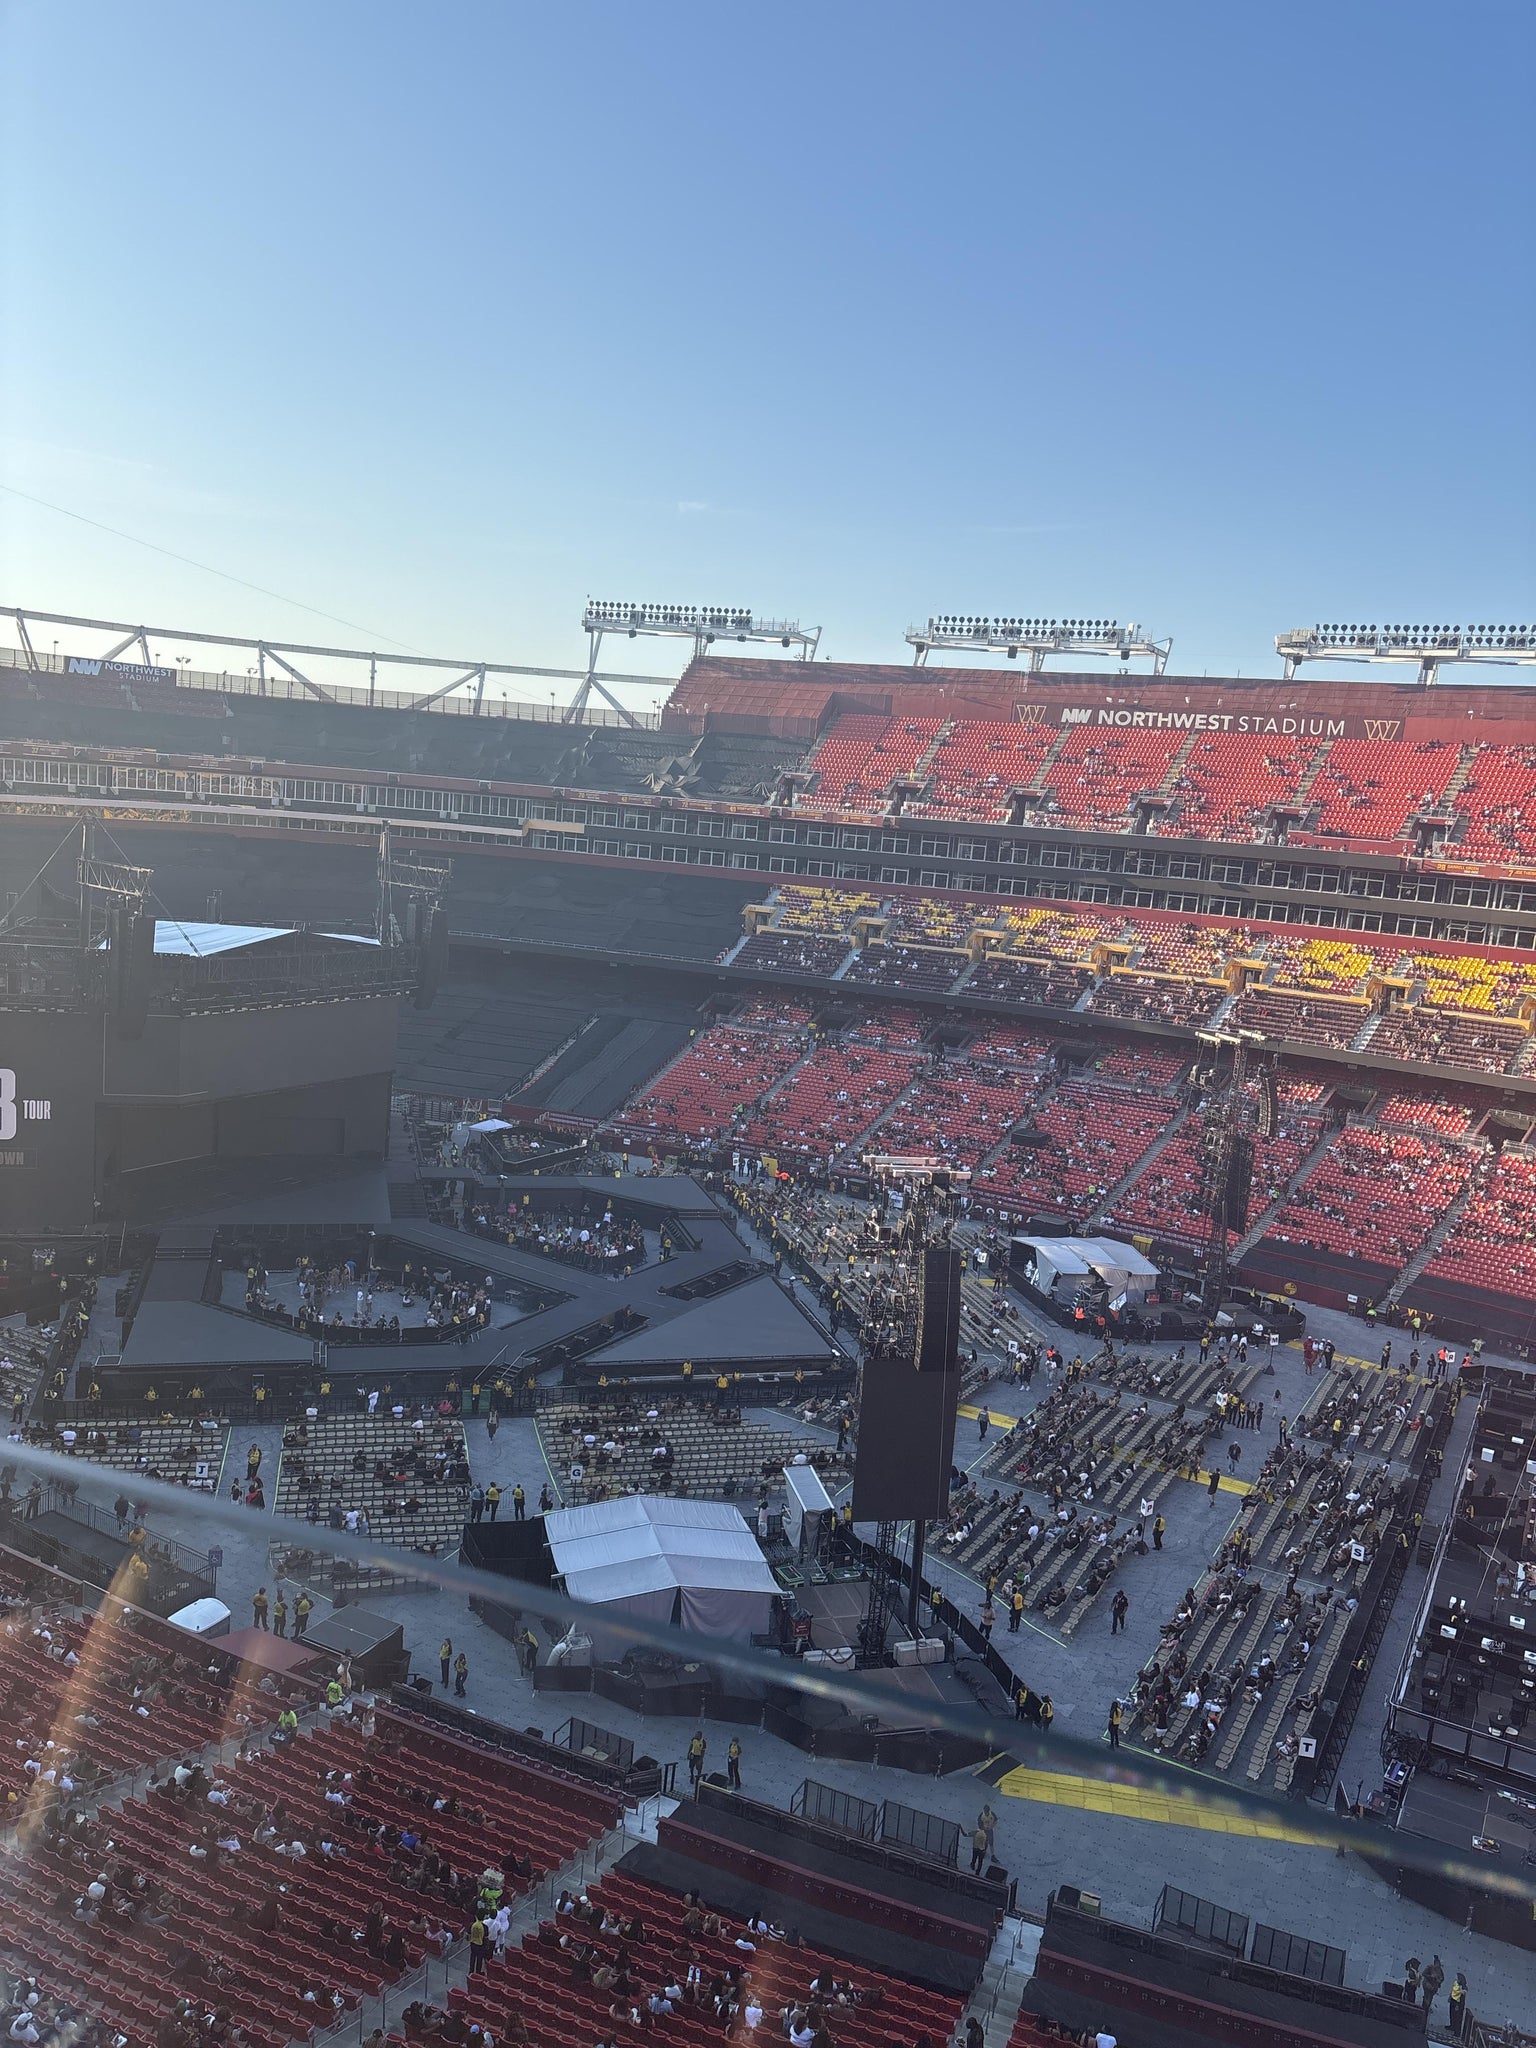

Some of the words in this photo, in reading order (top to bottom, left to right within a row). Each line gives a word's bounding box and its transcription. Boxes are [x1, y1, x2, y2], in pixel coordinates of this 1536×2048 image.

[68, 658, 102, 676] NW
[105, 662, 172, 677] NORTHWEST
[120, 673, 159, 683] STADIUM
[1061, 708, 1092, 724] NW
[1098, 710, 1234, 730] NORTHWEST
[1238, 715, 1345, 736] STADIUM
[23, 1100, 51, 1120] TOUR
[198, 1465, 206, 1474] J
[572, 1469, 581, 1477] G
[1353, 1548, 1362, 1557] S
[1302, 1742, 1313, 1753] T
